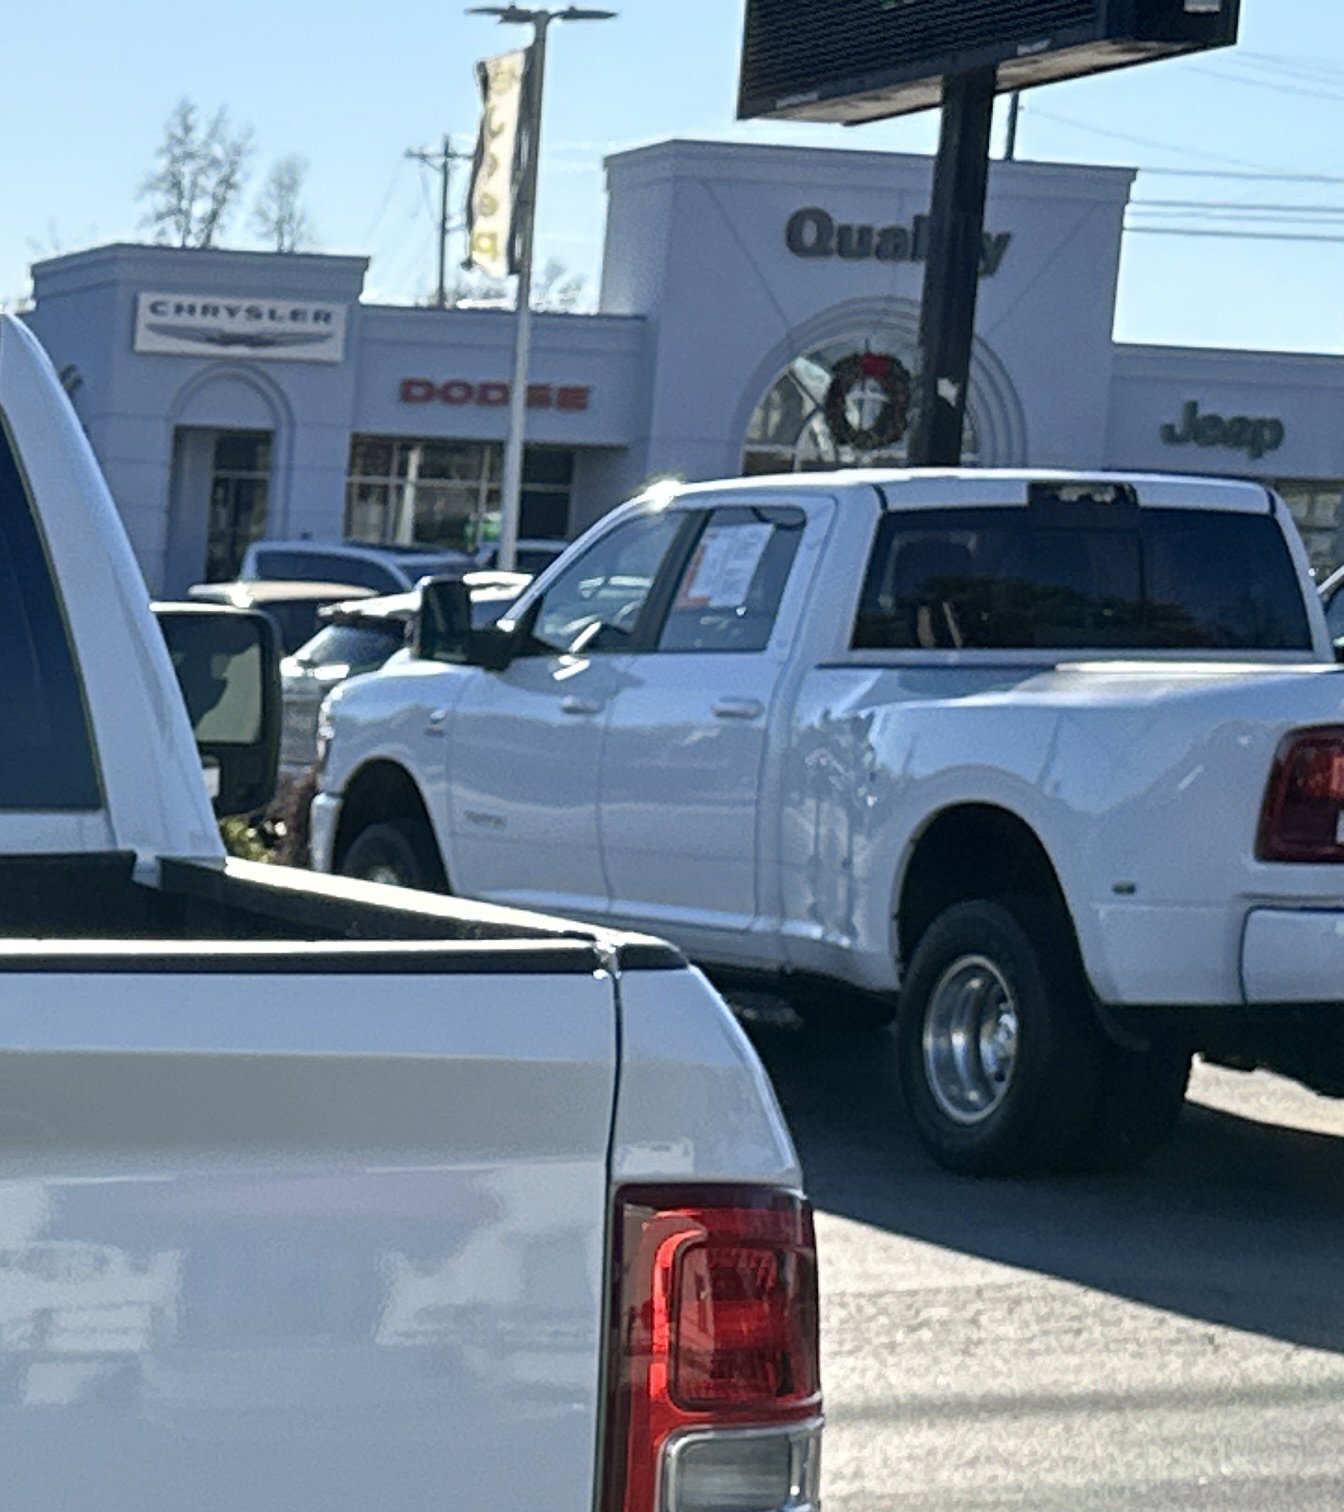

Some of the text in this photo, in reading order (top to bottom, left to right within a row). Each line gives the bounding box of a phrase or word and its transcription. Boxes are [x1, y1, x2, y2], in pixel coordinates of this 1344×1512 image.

[786, 207, 1011, 277] Qualy
[148, 300, 333, 324] CHRYSLER
[401, 378, 589, 411] DODGE
[1159, 400, 1284, 459] Jeep
